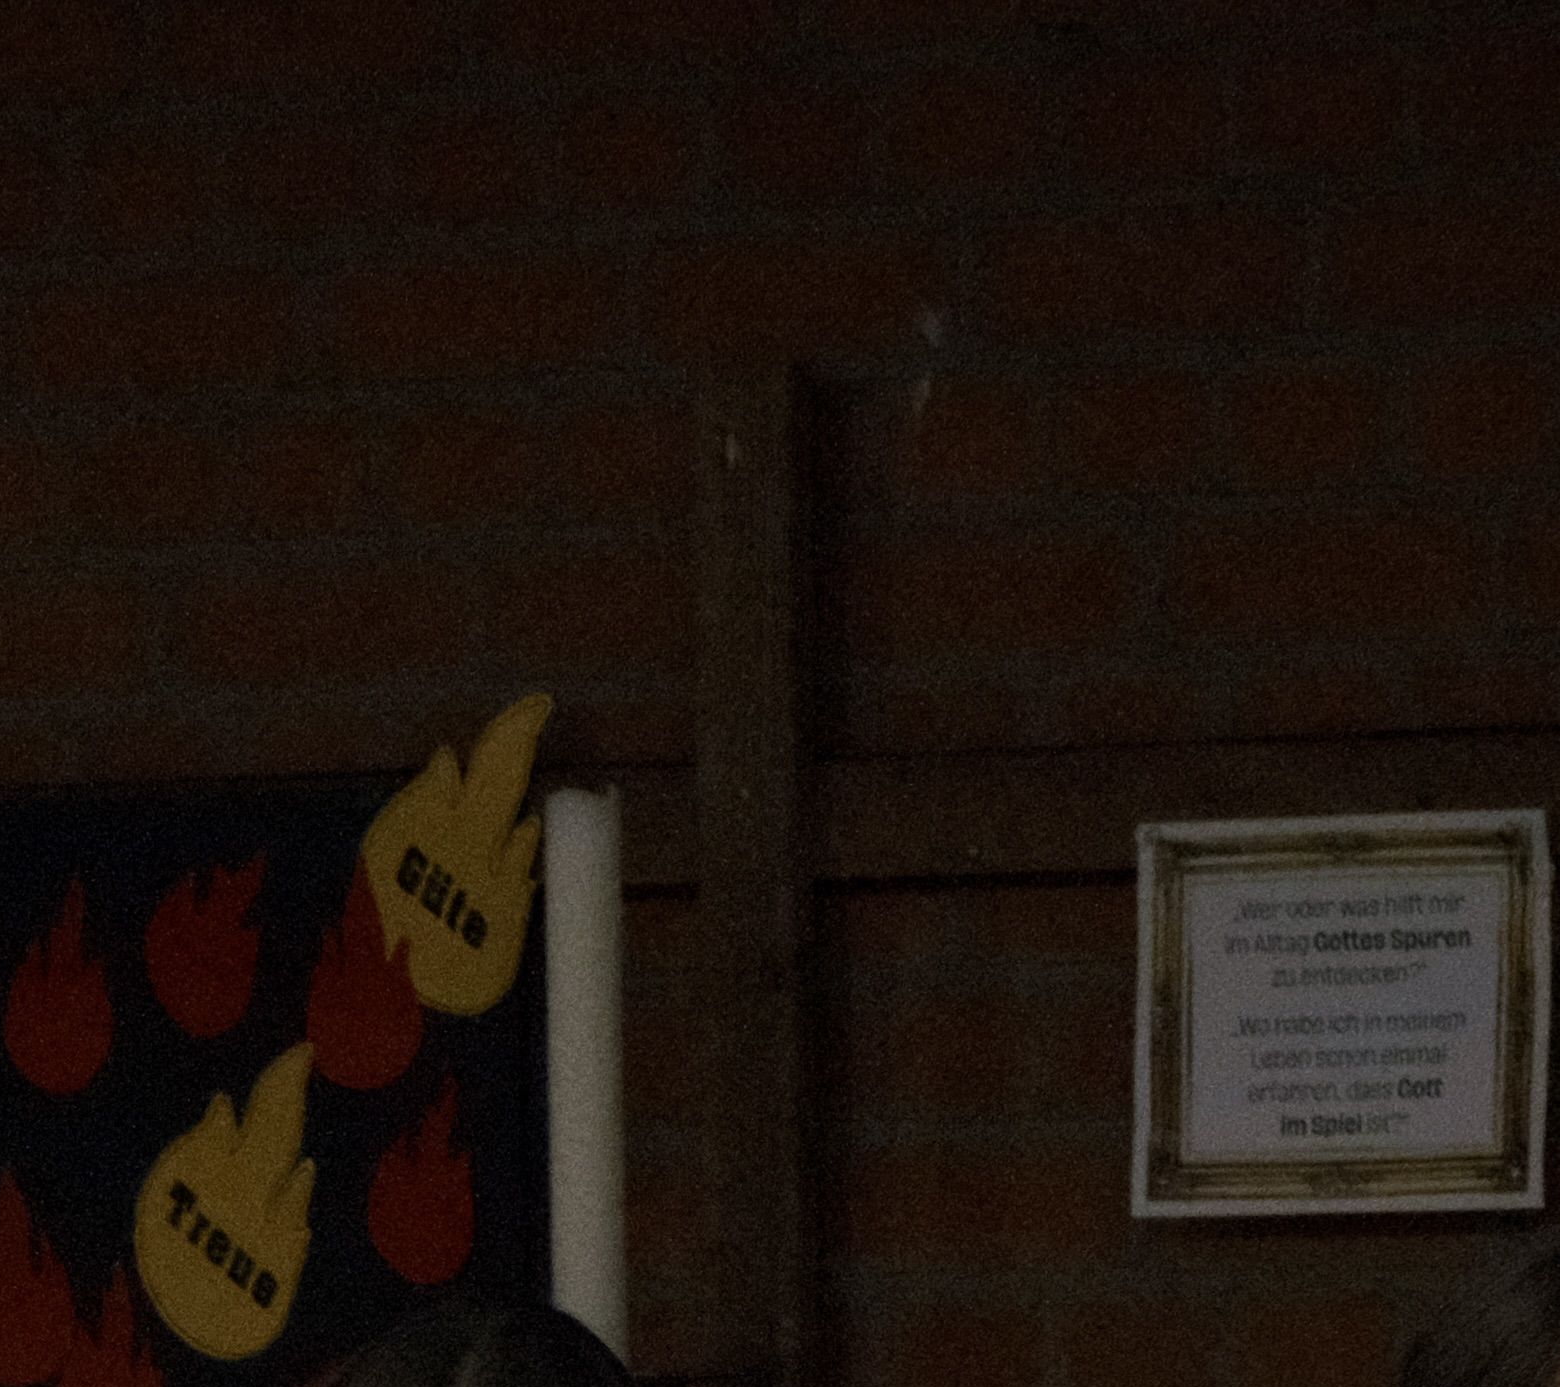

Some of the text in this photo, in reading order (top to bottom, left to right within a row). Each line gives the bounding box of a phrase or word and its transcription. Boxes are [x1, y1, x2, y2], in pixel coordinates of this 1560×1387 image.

[397, 845, 488, 949] Güte
[1341, 899, 1380, 918] was
[1383, 895, 1424, 916] hilft
[1430, 894, 1466, 914] mir
[1313, 931, 1386, 951] Gottes
[1390, 928, 1472, 951] Spuren
[1250, 1049, 1312, 1071] Leben
[1314, 1048, 1379, 1068] schon
[1396, 1076, 1443, 1099] Gott
[1280, 1113, 1308, 1137] im
[1311, 1112, 1363, 1137] Spiel
[168, 1180, 278, 1309] Treue
